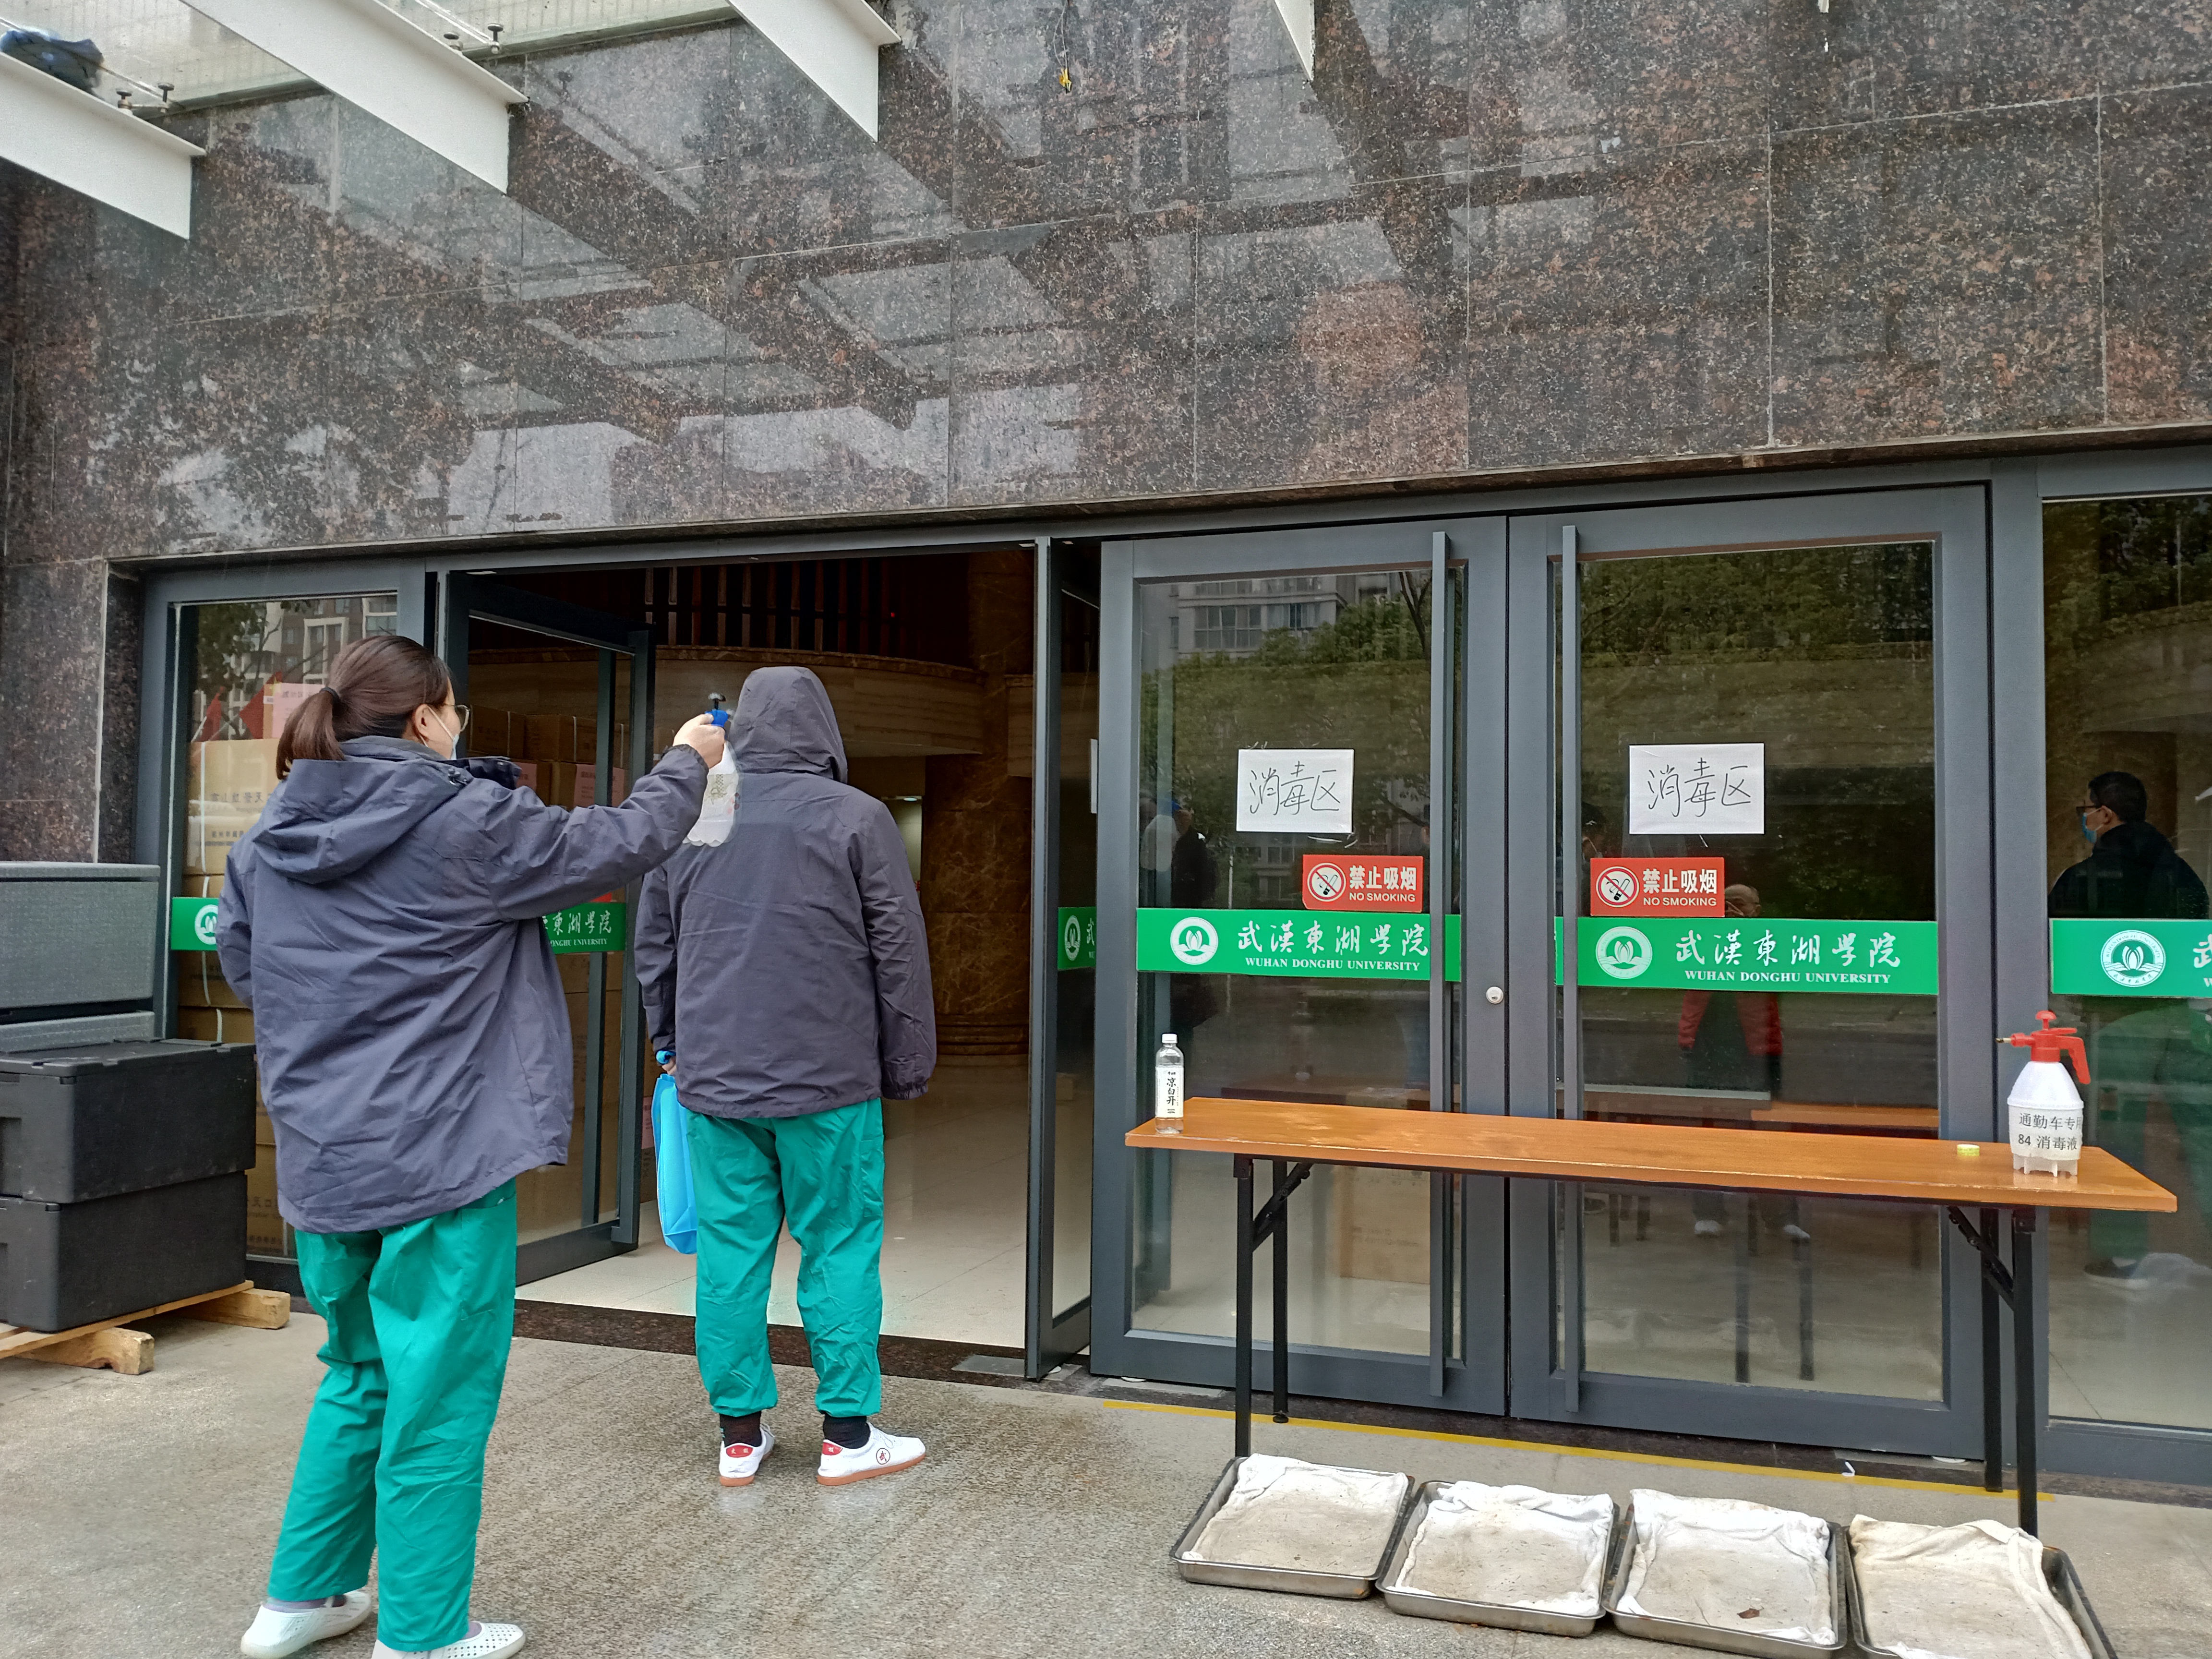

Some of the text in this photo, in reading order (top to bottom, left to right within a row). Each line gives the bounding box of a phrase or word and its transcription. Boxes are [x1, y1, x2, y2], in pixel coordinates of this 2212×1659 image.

[1250, 760, 1341, 816] 消毒区
[1647, 757, 1751, 817] 消毒区
[1349, 865, 1417, 890] 禁止吸烟
[1642, 868, 1718, 894] 禁止吸烟
[1349, 892, 1416, 902] NO SMOKING
[1643, 897, 1717, 906] NO SMOKING
[1245, 957, 1420, 971] WUHAN DONGHU UNIVERSITY
[1684, 970, 1891, 984] WUHAN DONGHU UNIVERSITY
[2018, 1134, 2078, 1151] 84 消毒液
